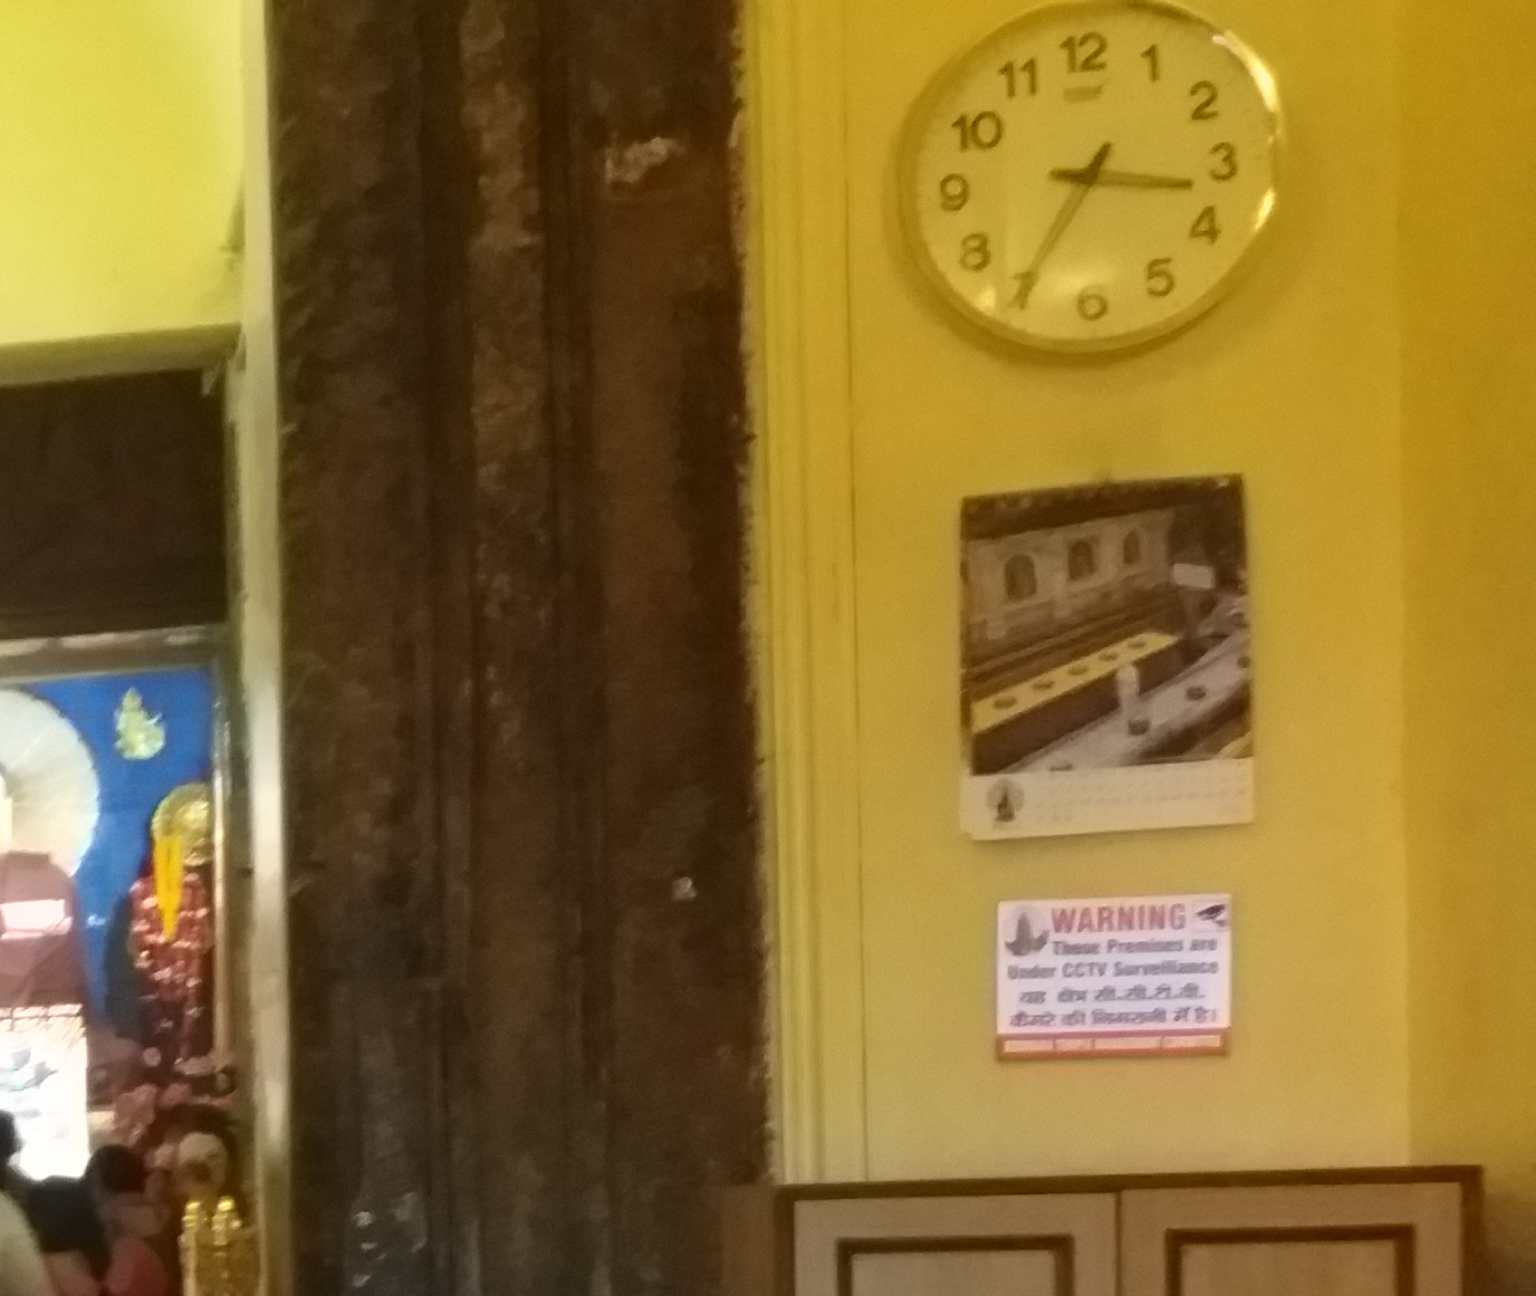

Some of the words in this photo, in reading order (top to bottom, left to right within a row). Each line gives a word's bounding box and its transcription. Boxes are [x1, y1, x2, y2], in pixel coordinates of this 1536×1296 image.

[1059, 32, 1108, 73] 12
[1140, 43, 1160, 82] 1
[998, 58, 1038, 98] 11
[1189, 81, 1219, 121] 2
[951, 110, 1003, 152] 10
[1208, 141, 1238, 181] 3
[939, 172, 969, 211] 9
[1189, 205, 1221, 245] 4
[958, 232, 991, 272] 8
[1146, 257, 1175, 297] 5
[1077, 284, 1109, 321] 6
[1050, 902, 1187, 934] WARNING
[1106, 938, 1183, 954] Premises
[1189, 938, 1218, 951] are
[1007, 964, 1057, 980] Under
[1062, 961, 1107, 978] CCTV
[1113, 959, 1219, 978] Surveillance
